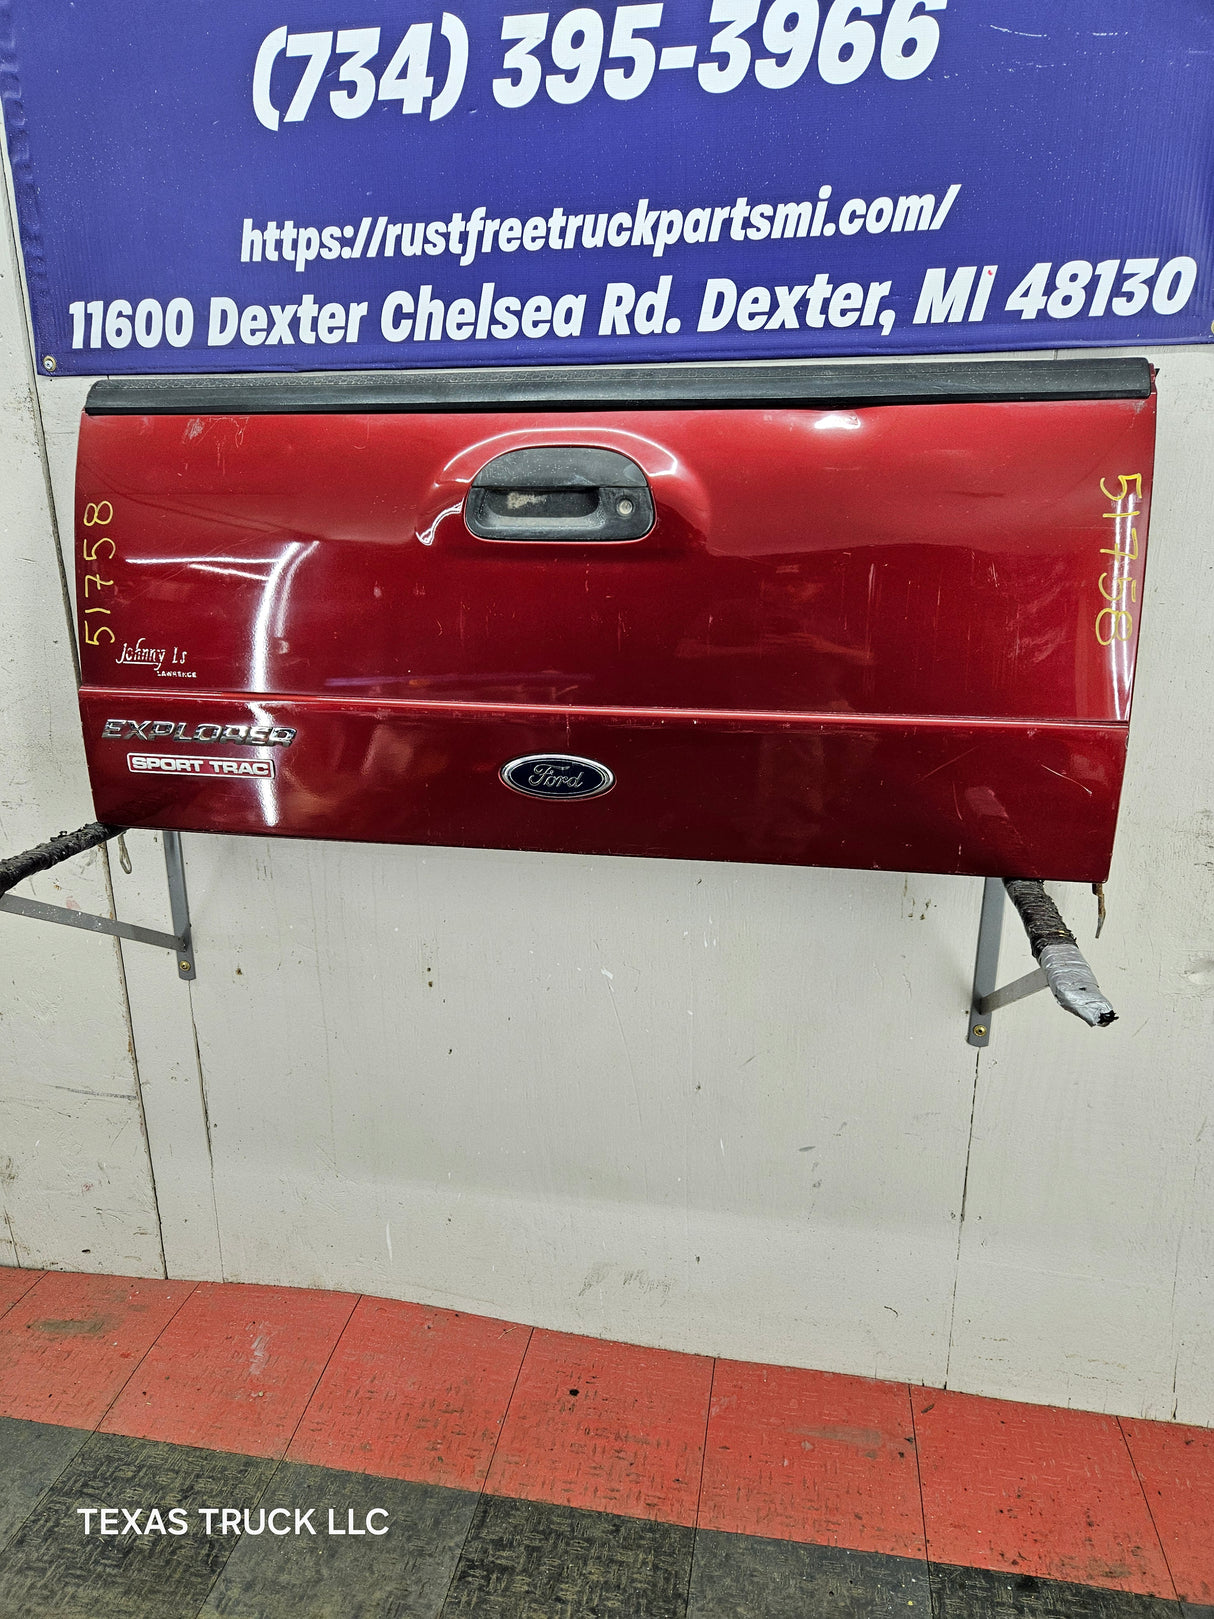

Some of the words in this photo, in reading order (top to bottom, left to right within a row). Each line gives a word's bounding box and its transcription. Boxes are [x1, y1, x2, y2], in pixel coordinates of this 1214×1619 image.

[252, 12, 469, 131] (734)
[492, 0, 947, 108] 395-3966
[240, 184, 962, 272] https://rustfreetruckpartsmi.com/
[68, 297, 194, 349] 11600
[207, 294, 367, 347] Dexter
[380, 282, 585, 343] Chelsea
[598, 275, 681, 337] Rd.
[697, 273, 895, 336] Dexter,
[912, 265, 998, 325] MI
[1005, 256, 1198, 320] 48130
[83, 500, 116, 645] 51758
[1095, 473, 1143, 646] 51758
[101, 718, 298, 748] EXPLORER
[131, 756, 202, 774] SPORT
[209, 760, 270, 776] TRAC
[528, 763, 584, 789] Ford
